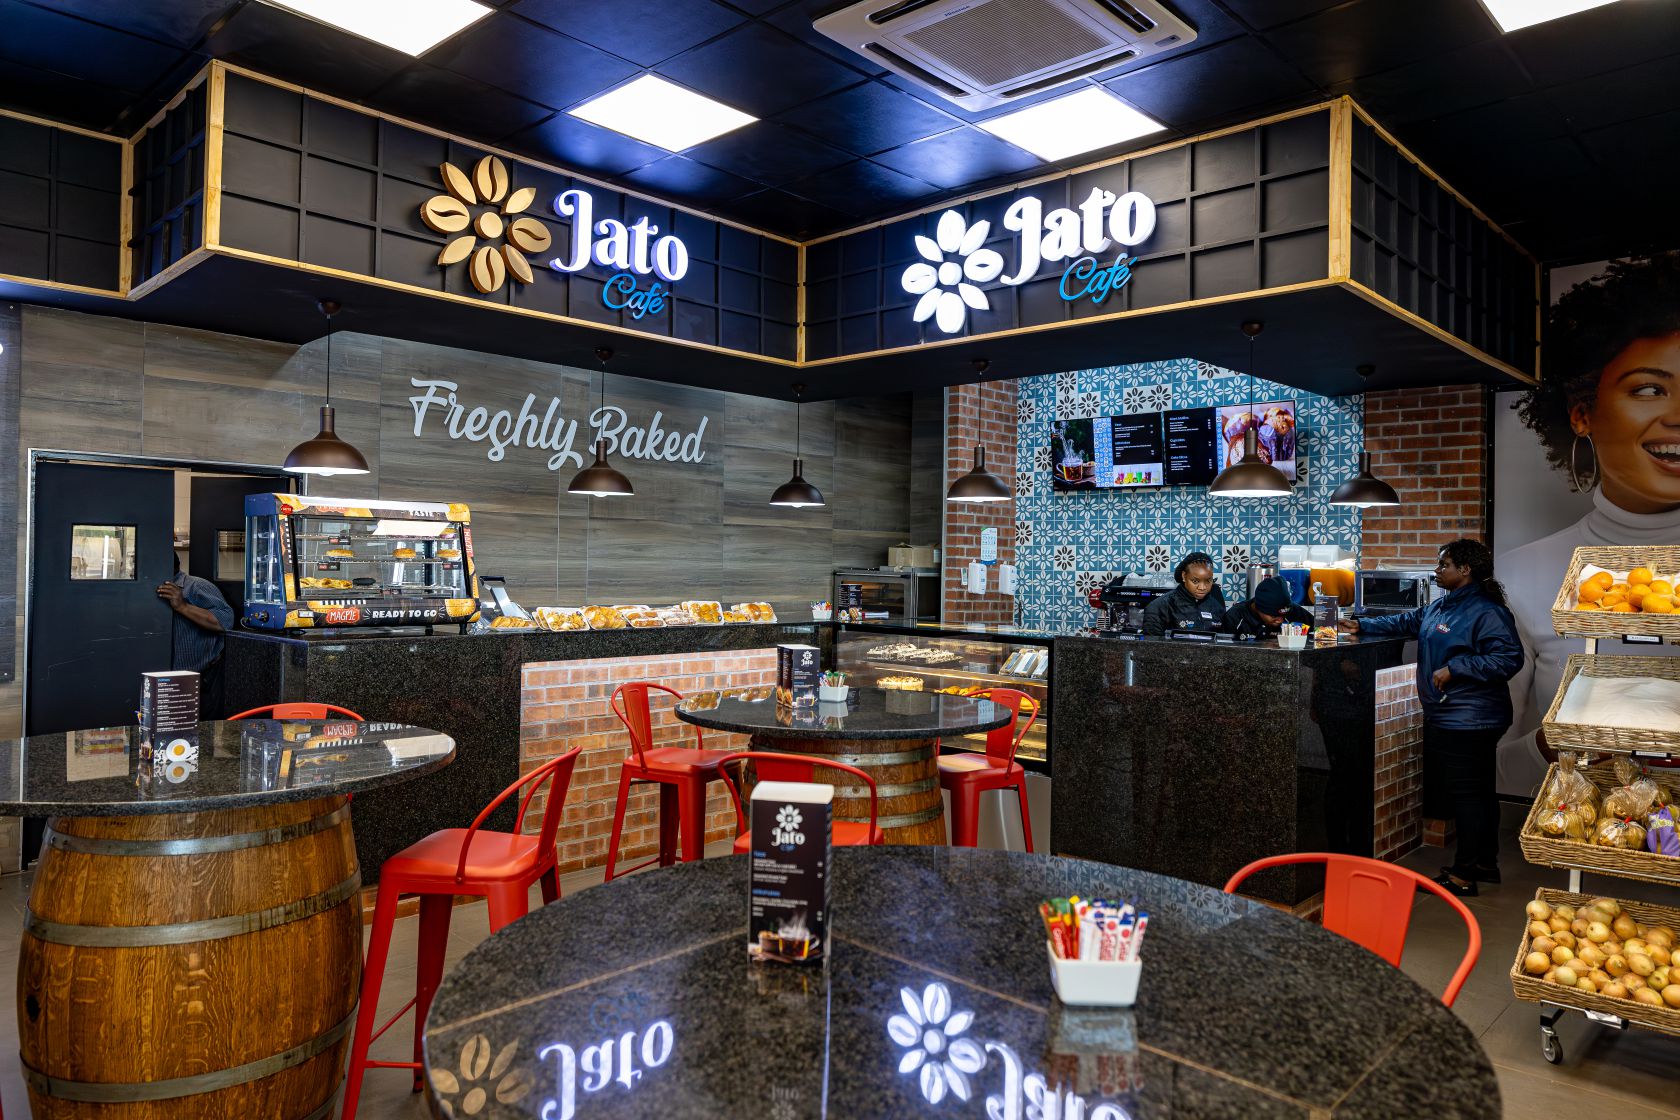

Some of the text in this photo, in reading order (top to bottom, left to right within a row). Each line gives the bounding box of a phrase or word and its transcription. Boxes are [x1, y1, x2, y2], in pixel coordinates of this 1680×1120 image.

[549, 189, 689, 282] Jato
[1000, 187, 1156, 286] Jato
[602, 273, 669, 319] Café
[1059, 253, 1137, 303] Café
[409, 376, 709, 470] Freshly Baked
[329, 611, 356, 621] MAGPIE
[372, 609, 437, 619] READY TO GO
[770, 827, 806, 847] Jato
